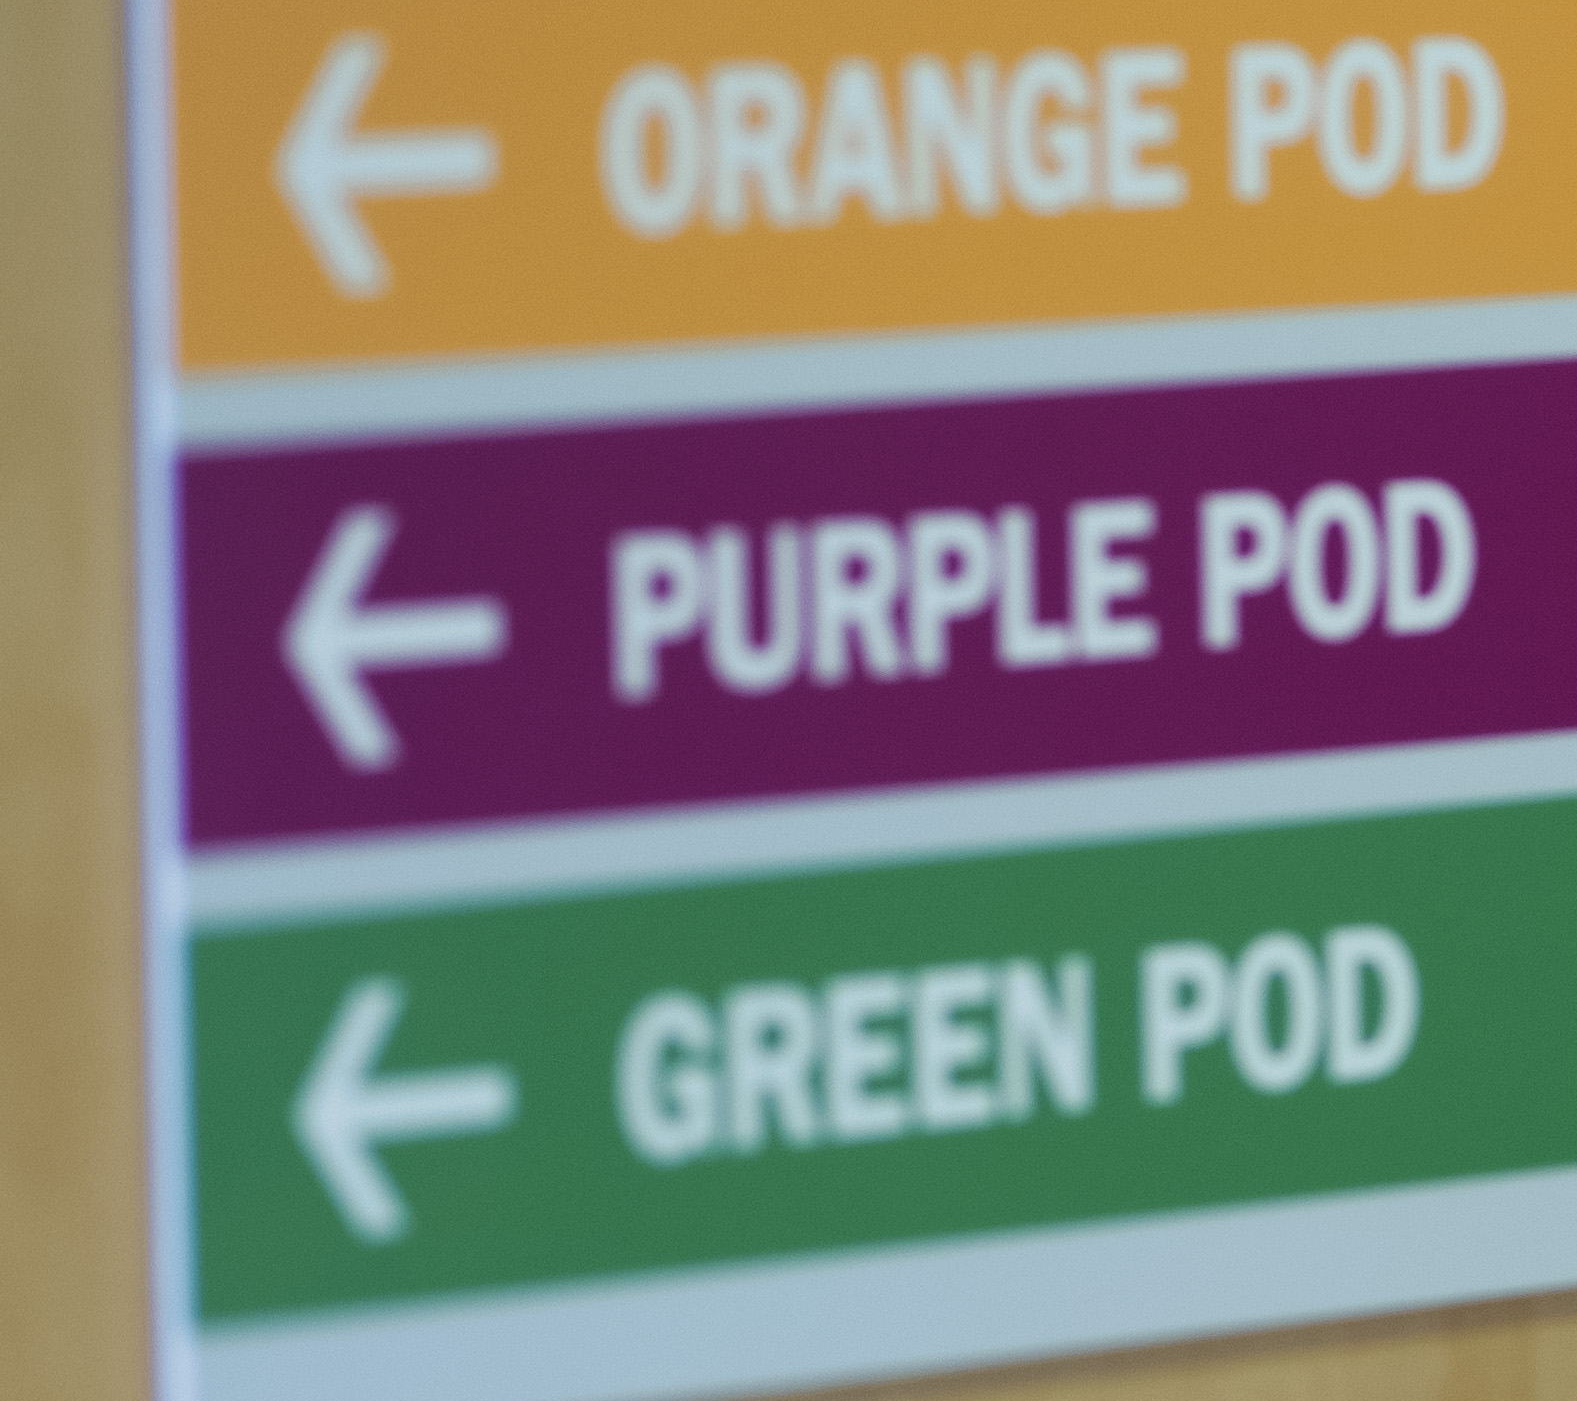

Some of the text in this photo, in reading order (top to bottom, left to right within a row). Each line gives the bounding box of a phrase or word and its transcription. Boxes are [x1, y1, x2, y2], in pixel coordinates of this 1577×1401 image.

[602, 36, 1505, 238] ORANGE POD
[610, 478, 1475, 702] PURPLE POD
[618, 926, 1418, 1160] GREEN POD
